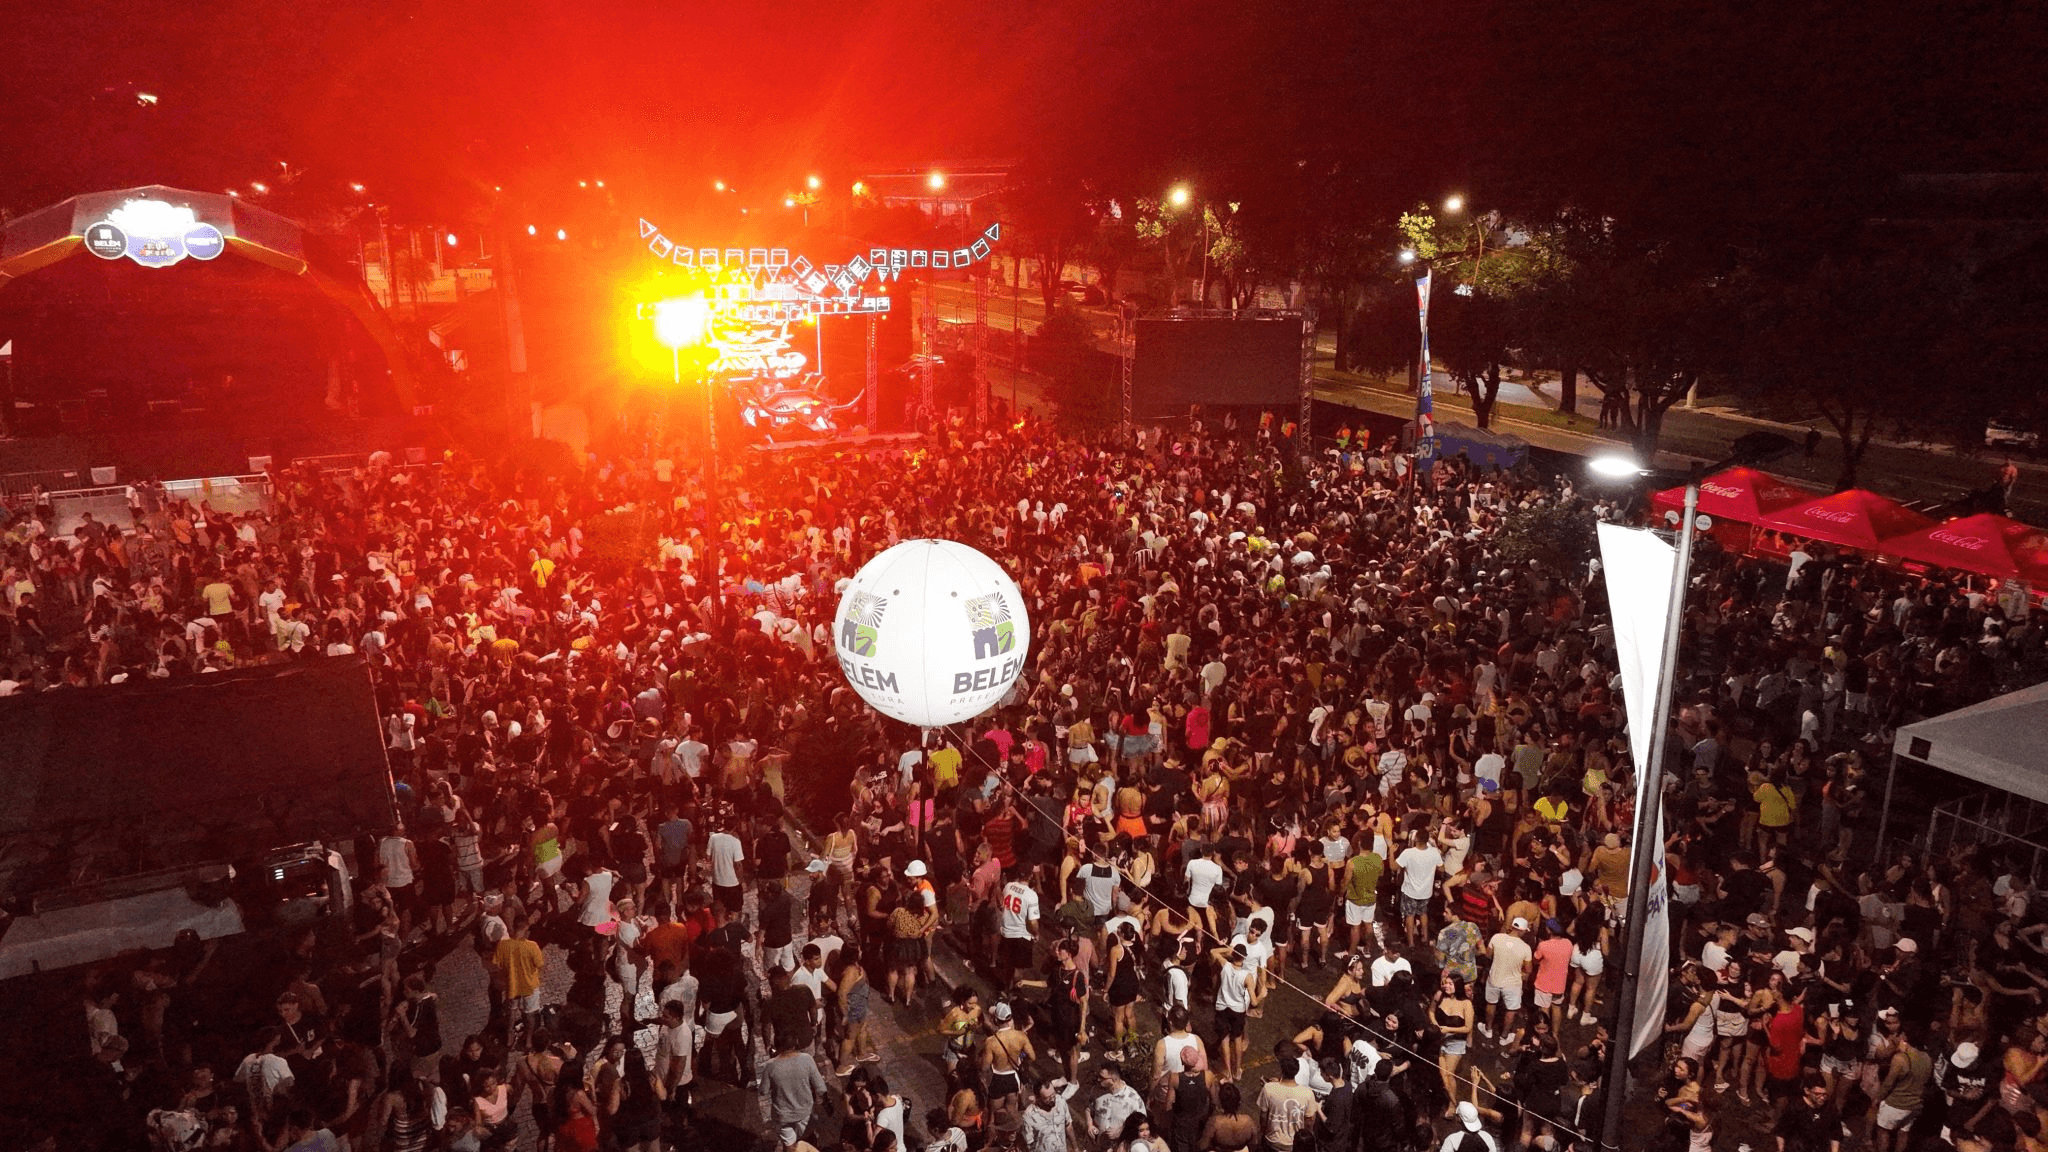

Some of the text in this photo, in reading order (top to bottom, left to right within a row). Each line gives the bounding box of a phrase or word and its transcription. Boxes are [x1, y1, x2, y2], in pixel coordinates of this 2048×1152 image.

[1804, 506, 1857, 523] Coca-Cola
[1929, 530, 1988, 550] Coca-Cola
[953, 653, 1024, 694] BELÉM
[1004, 894, 1022, 914] 46
